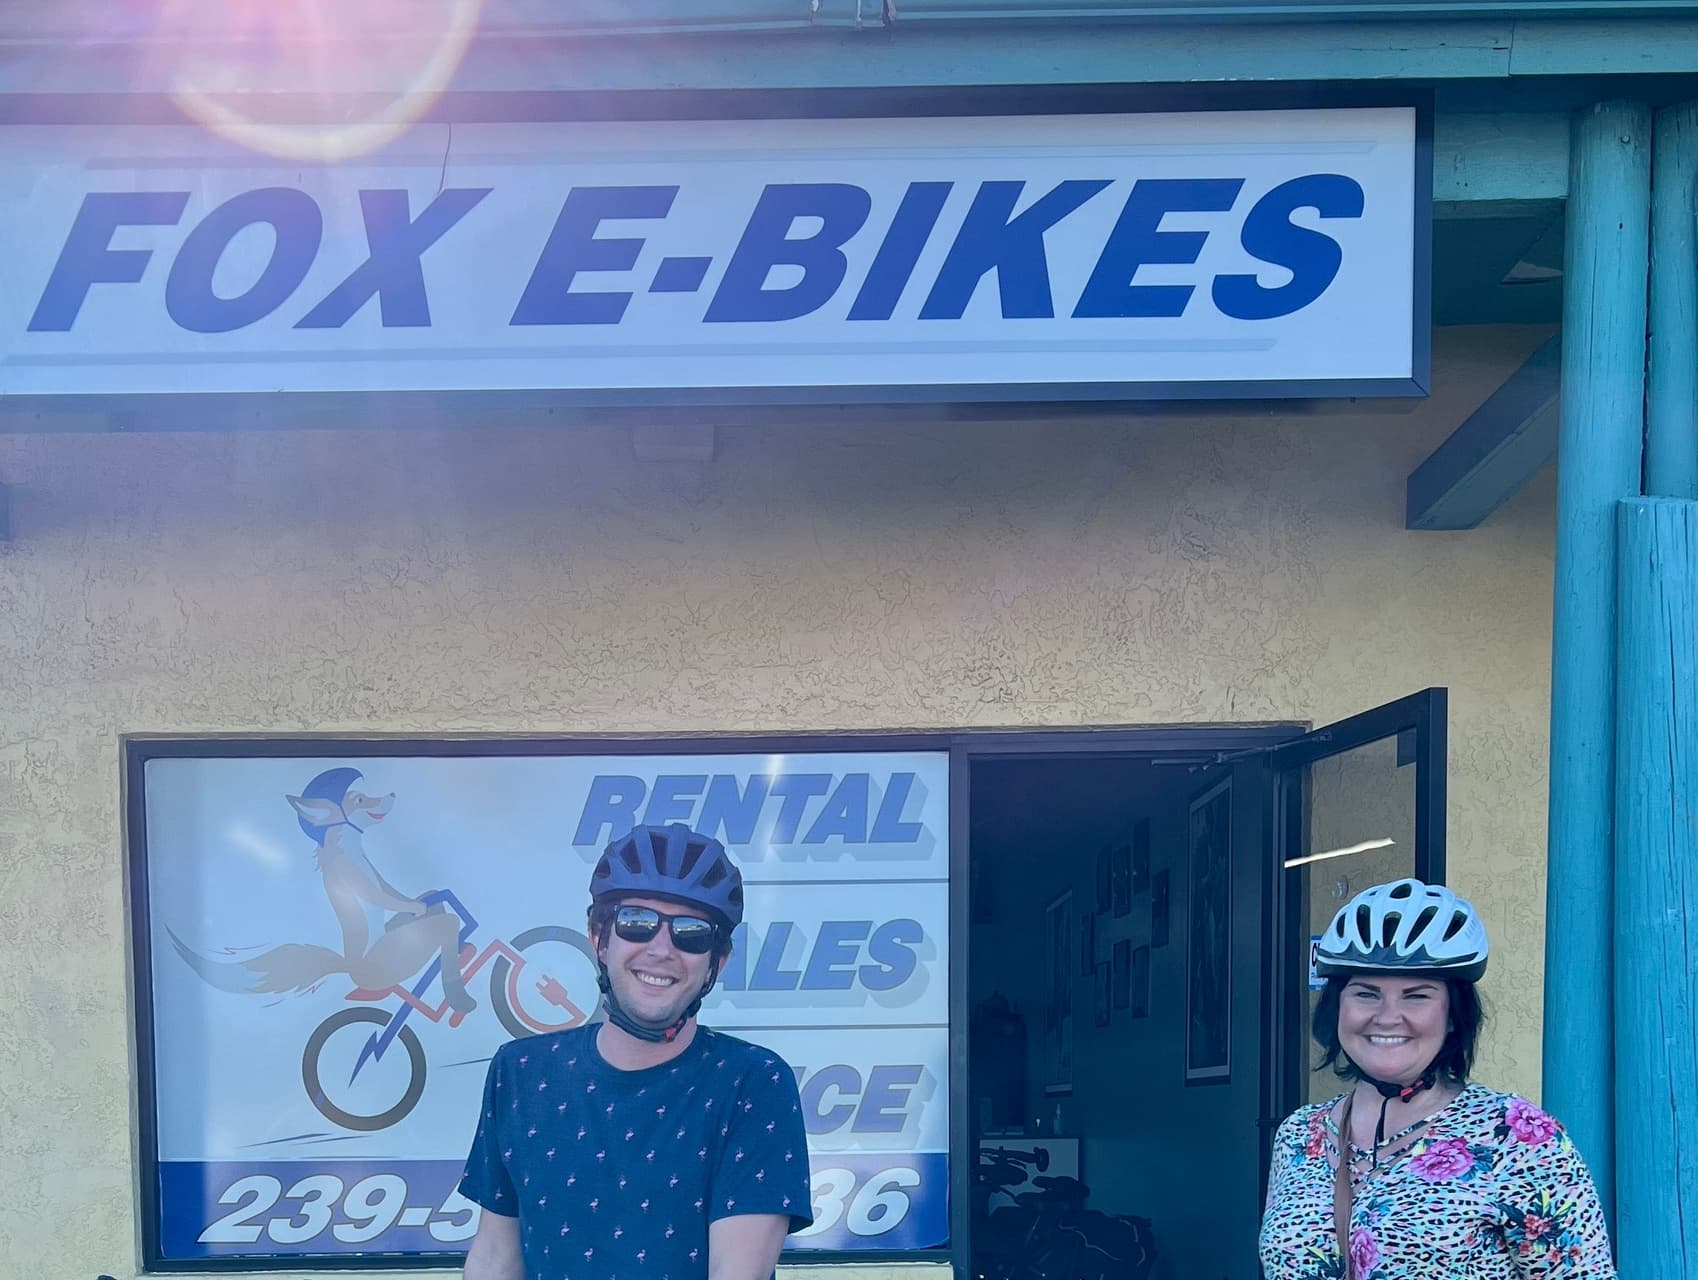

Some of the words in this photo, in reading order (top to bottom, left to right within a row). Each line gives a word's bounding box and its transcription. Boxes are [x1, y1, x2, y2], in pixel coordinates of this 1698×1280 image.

[26, 186, 495, 334] FOX
[508, 173, 1366, 327] E-BIKES
[571, 772, 925, 847] RENTAL
[715, 918, 925, 992] ALES
